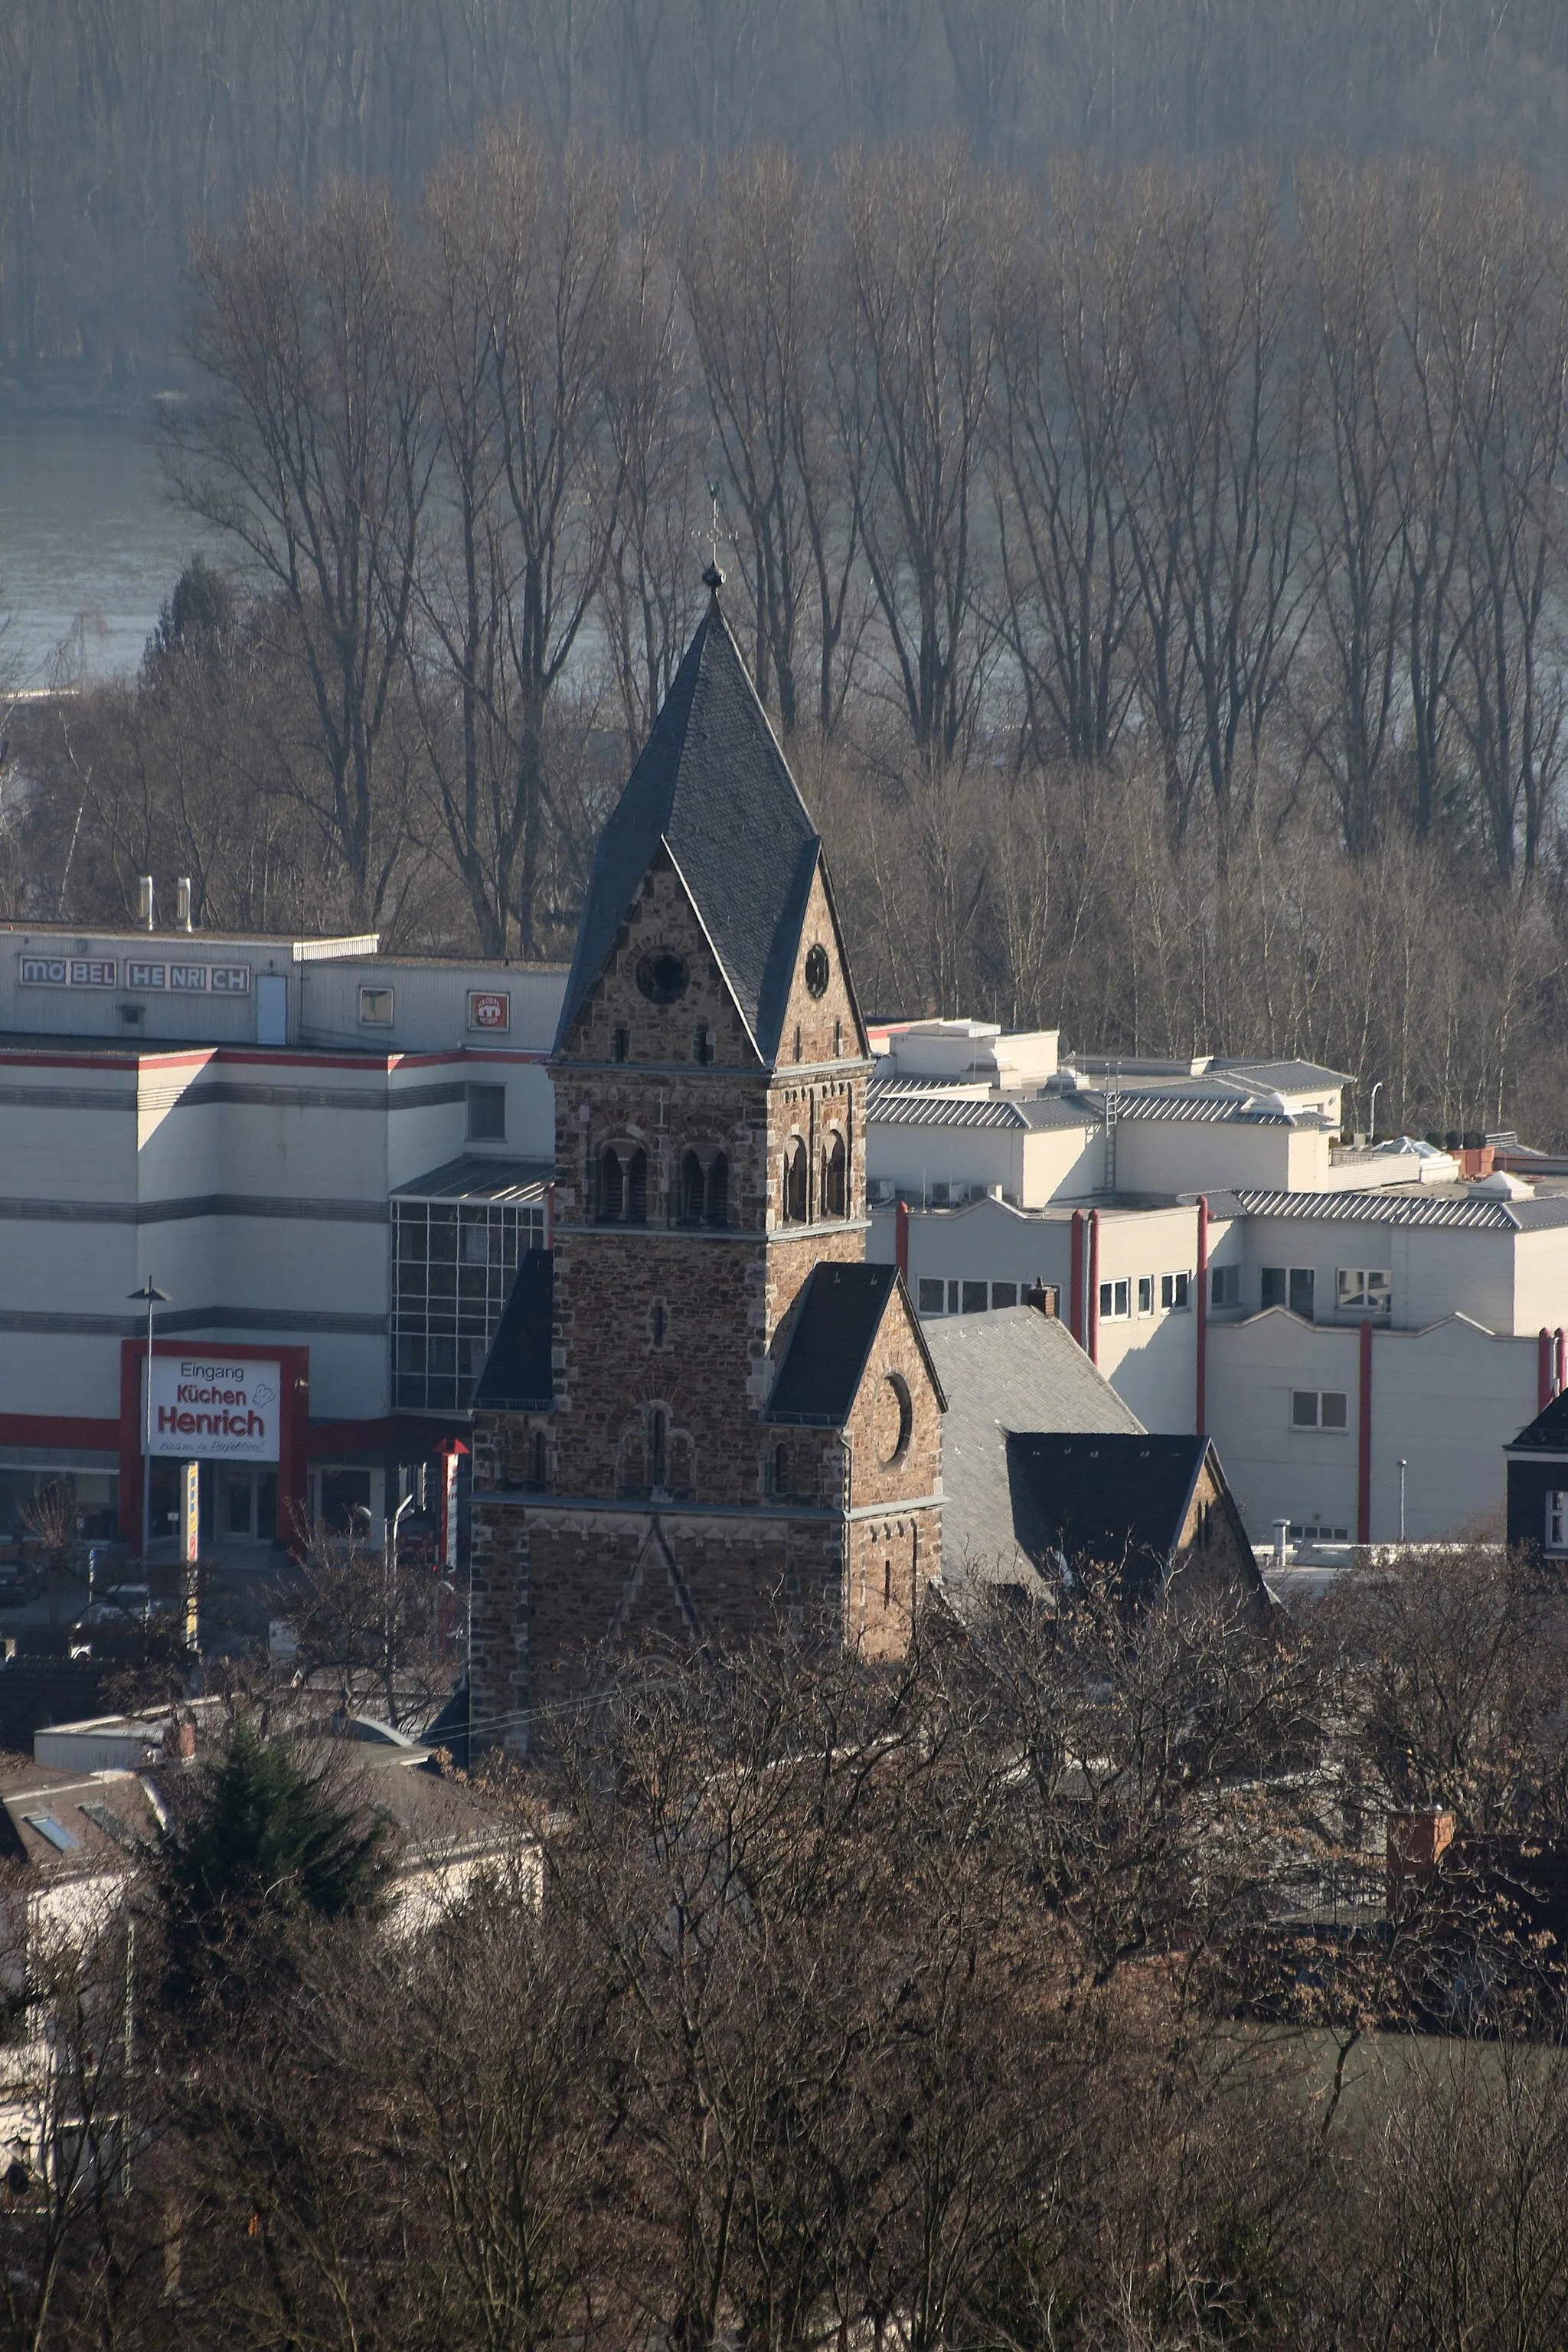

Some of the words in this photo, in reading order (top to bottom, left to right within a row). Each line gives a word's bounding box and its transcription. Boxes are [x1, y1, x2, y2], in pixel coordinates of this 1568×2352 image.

[133, 965, 244, 989] HENRICH
[181, 1362, 243, 1382] Eingang
[177, 1384, 247, 1406] Küchen
[158, 1406, 265, 1438] Henrich
